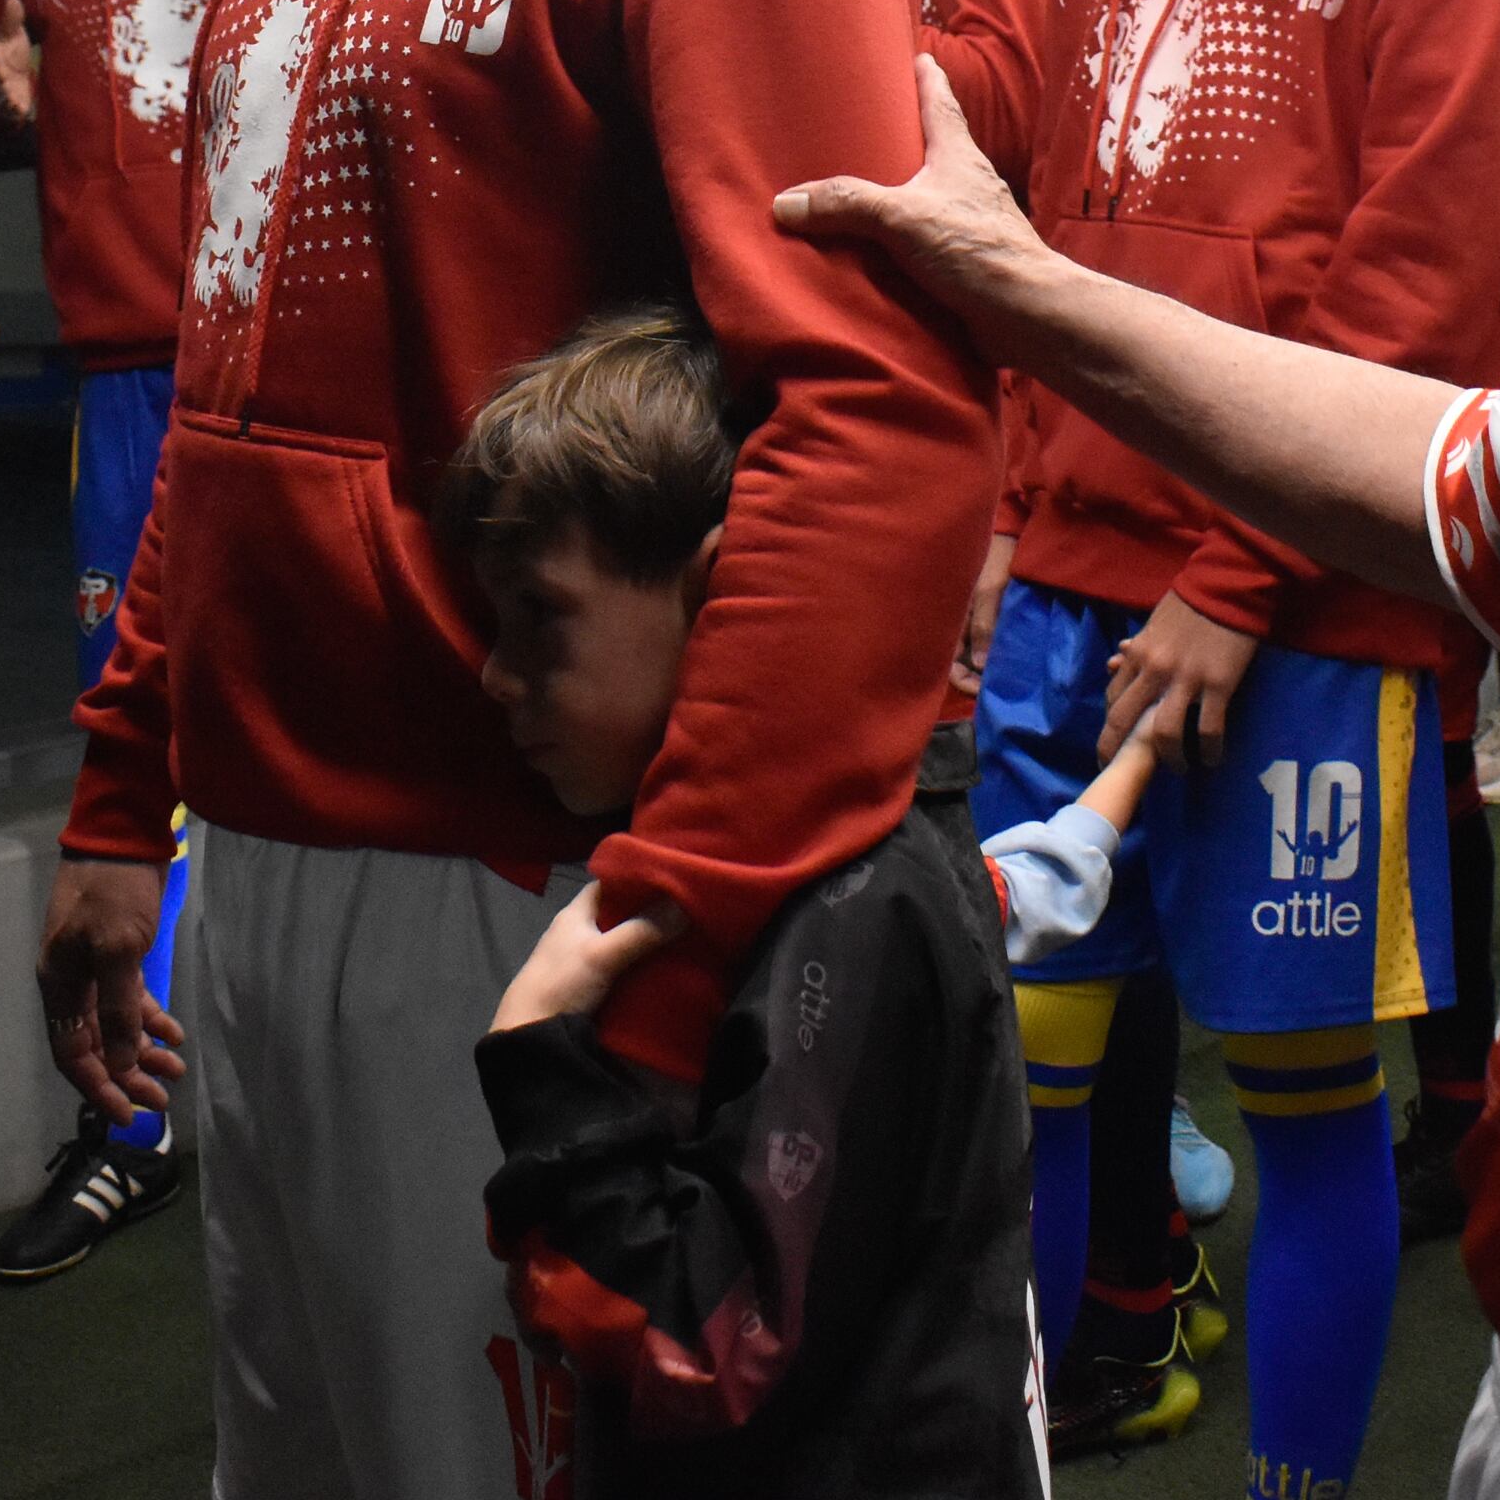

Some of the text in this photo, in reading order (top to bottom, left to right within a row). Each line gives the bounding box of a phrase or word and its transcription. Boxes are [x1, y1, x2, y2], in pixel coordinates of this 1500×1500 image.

[1257, 760, 1363, 881] 10
[1251, 890, 1363, 938] attle
[797, 959, 831, 1053] attle
